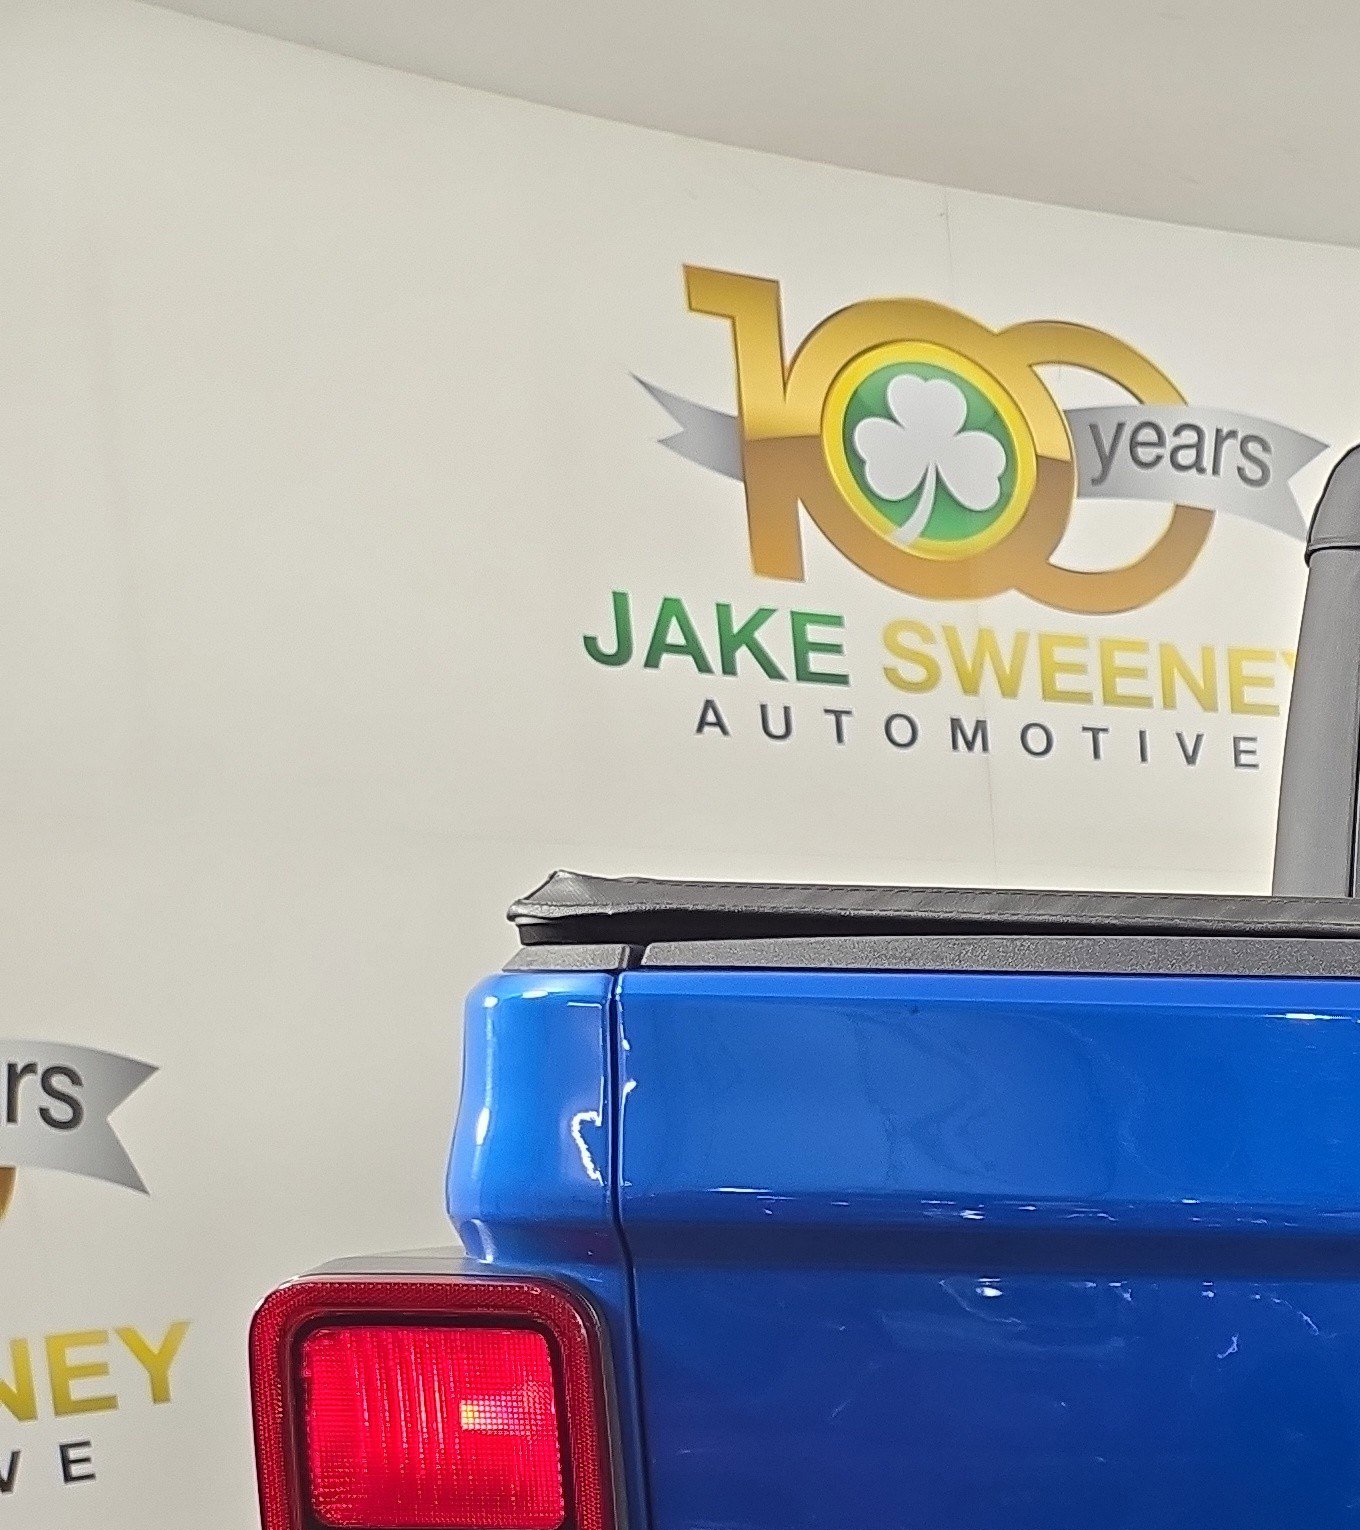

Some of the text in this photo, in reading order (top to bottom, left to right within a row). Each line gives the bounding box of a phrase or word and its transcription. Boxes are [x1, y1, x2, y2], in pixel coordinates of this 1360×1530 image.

[1088, 417, 1274, 489] years
[583, 591, 1297, 717] JAKE SWEENE
[695, 698, 1261, 770] AUTOMOTIVE
